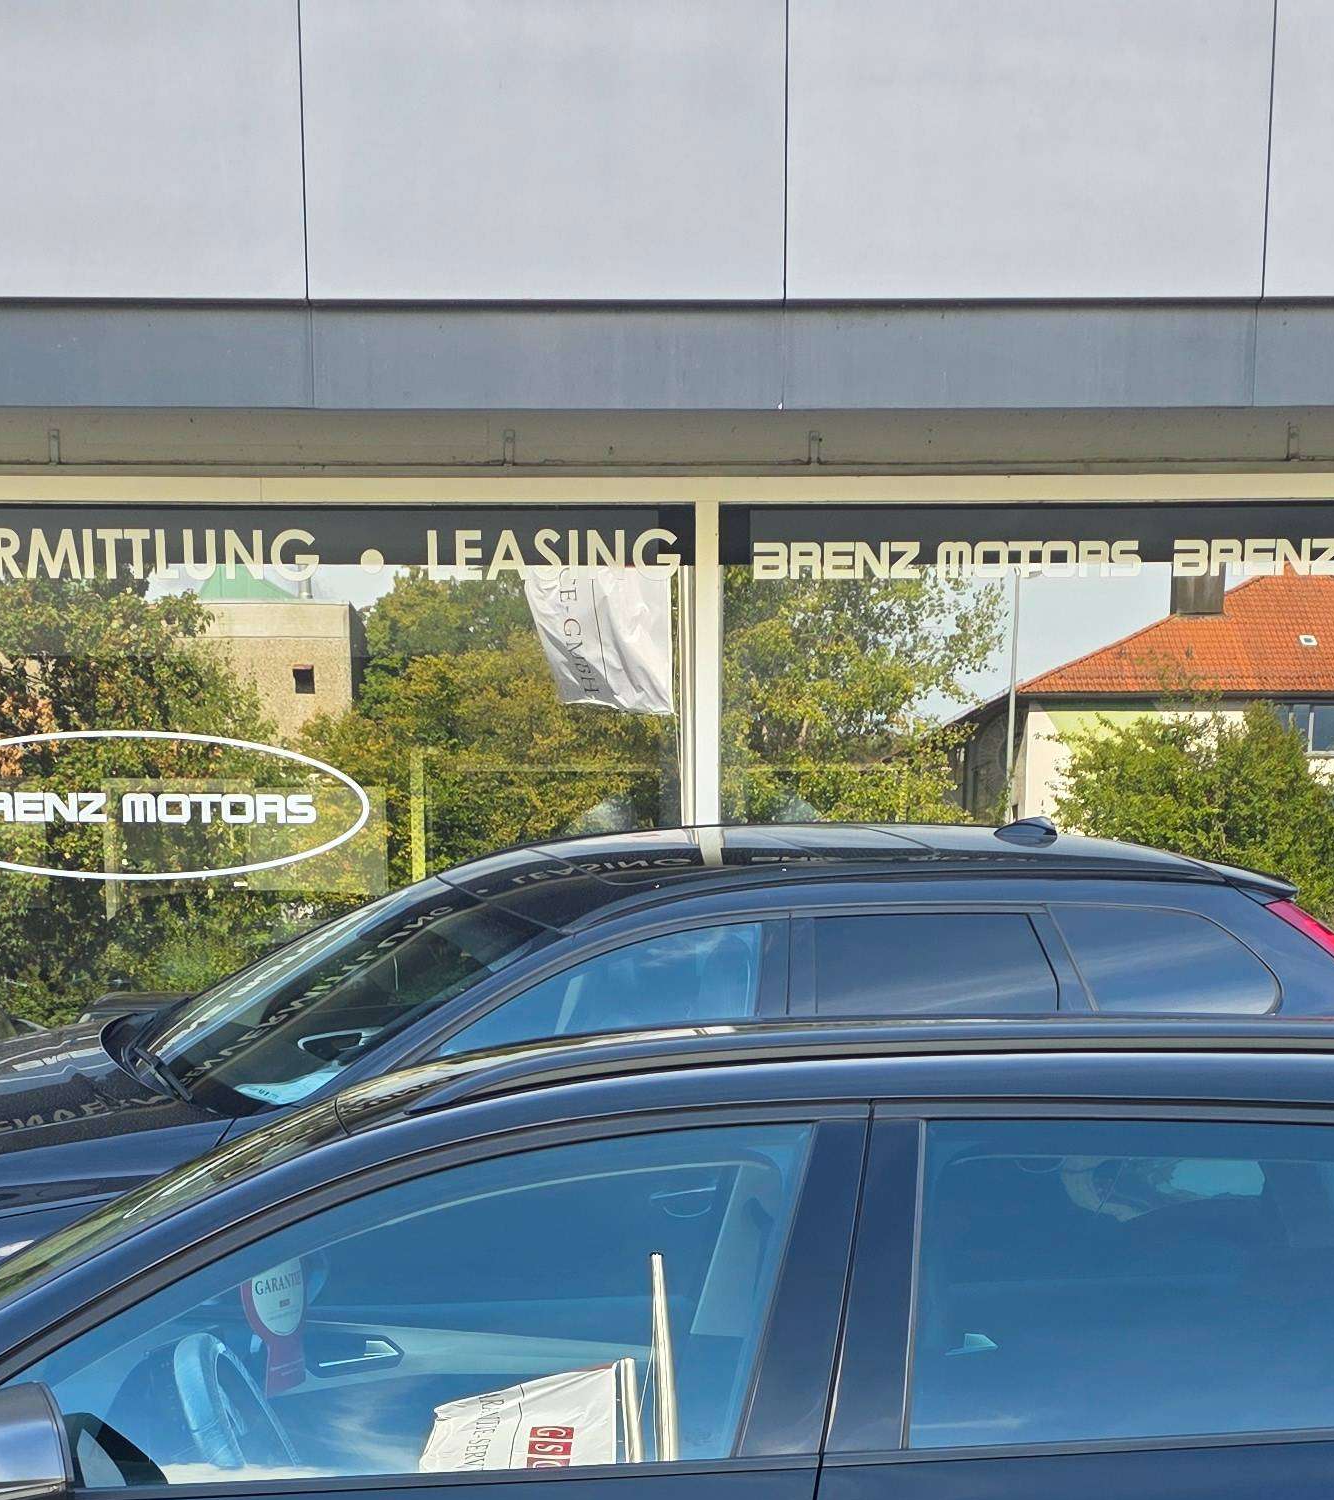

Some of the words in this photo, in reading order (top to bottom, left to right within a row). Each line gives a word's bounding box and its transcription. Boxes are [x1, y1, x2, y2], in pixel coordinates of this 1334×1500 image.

[426, 528, 682, 582] LEASING
[752, 541, 922, 581] BRENZ
[936, 540, 1142, 580] MOTORS
[121, 793, 317, 824] MOTORS
